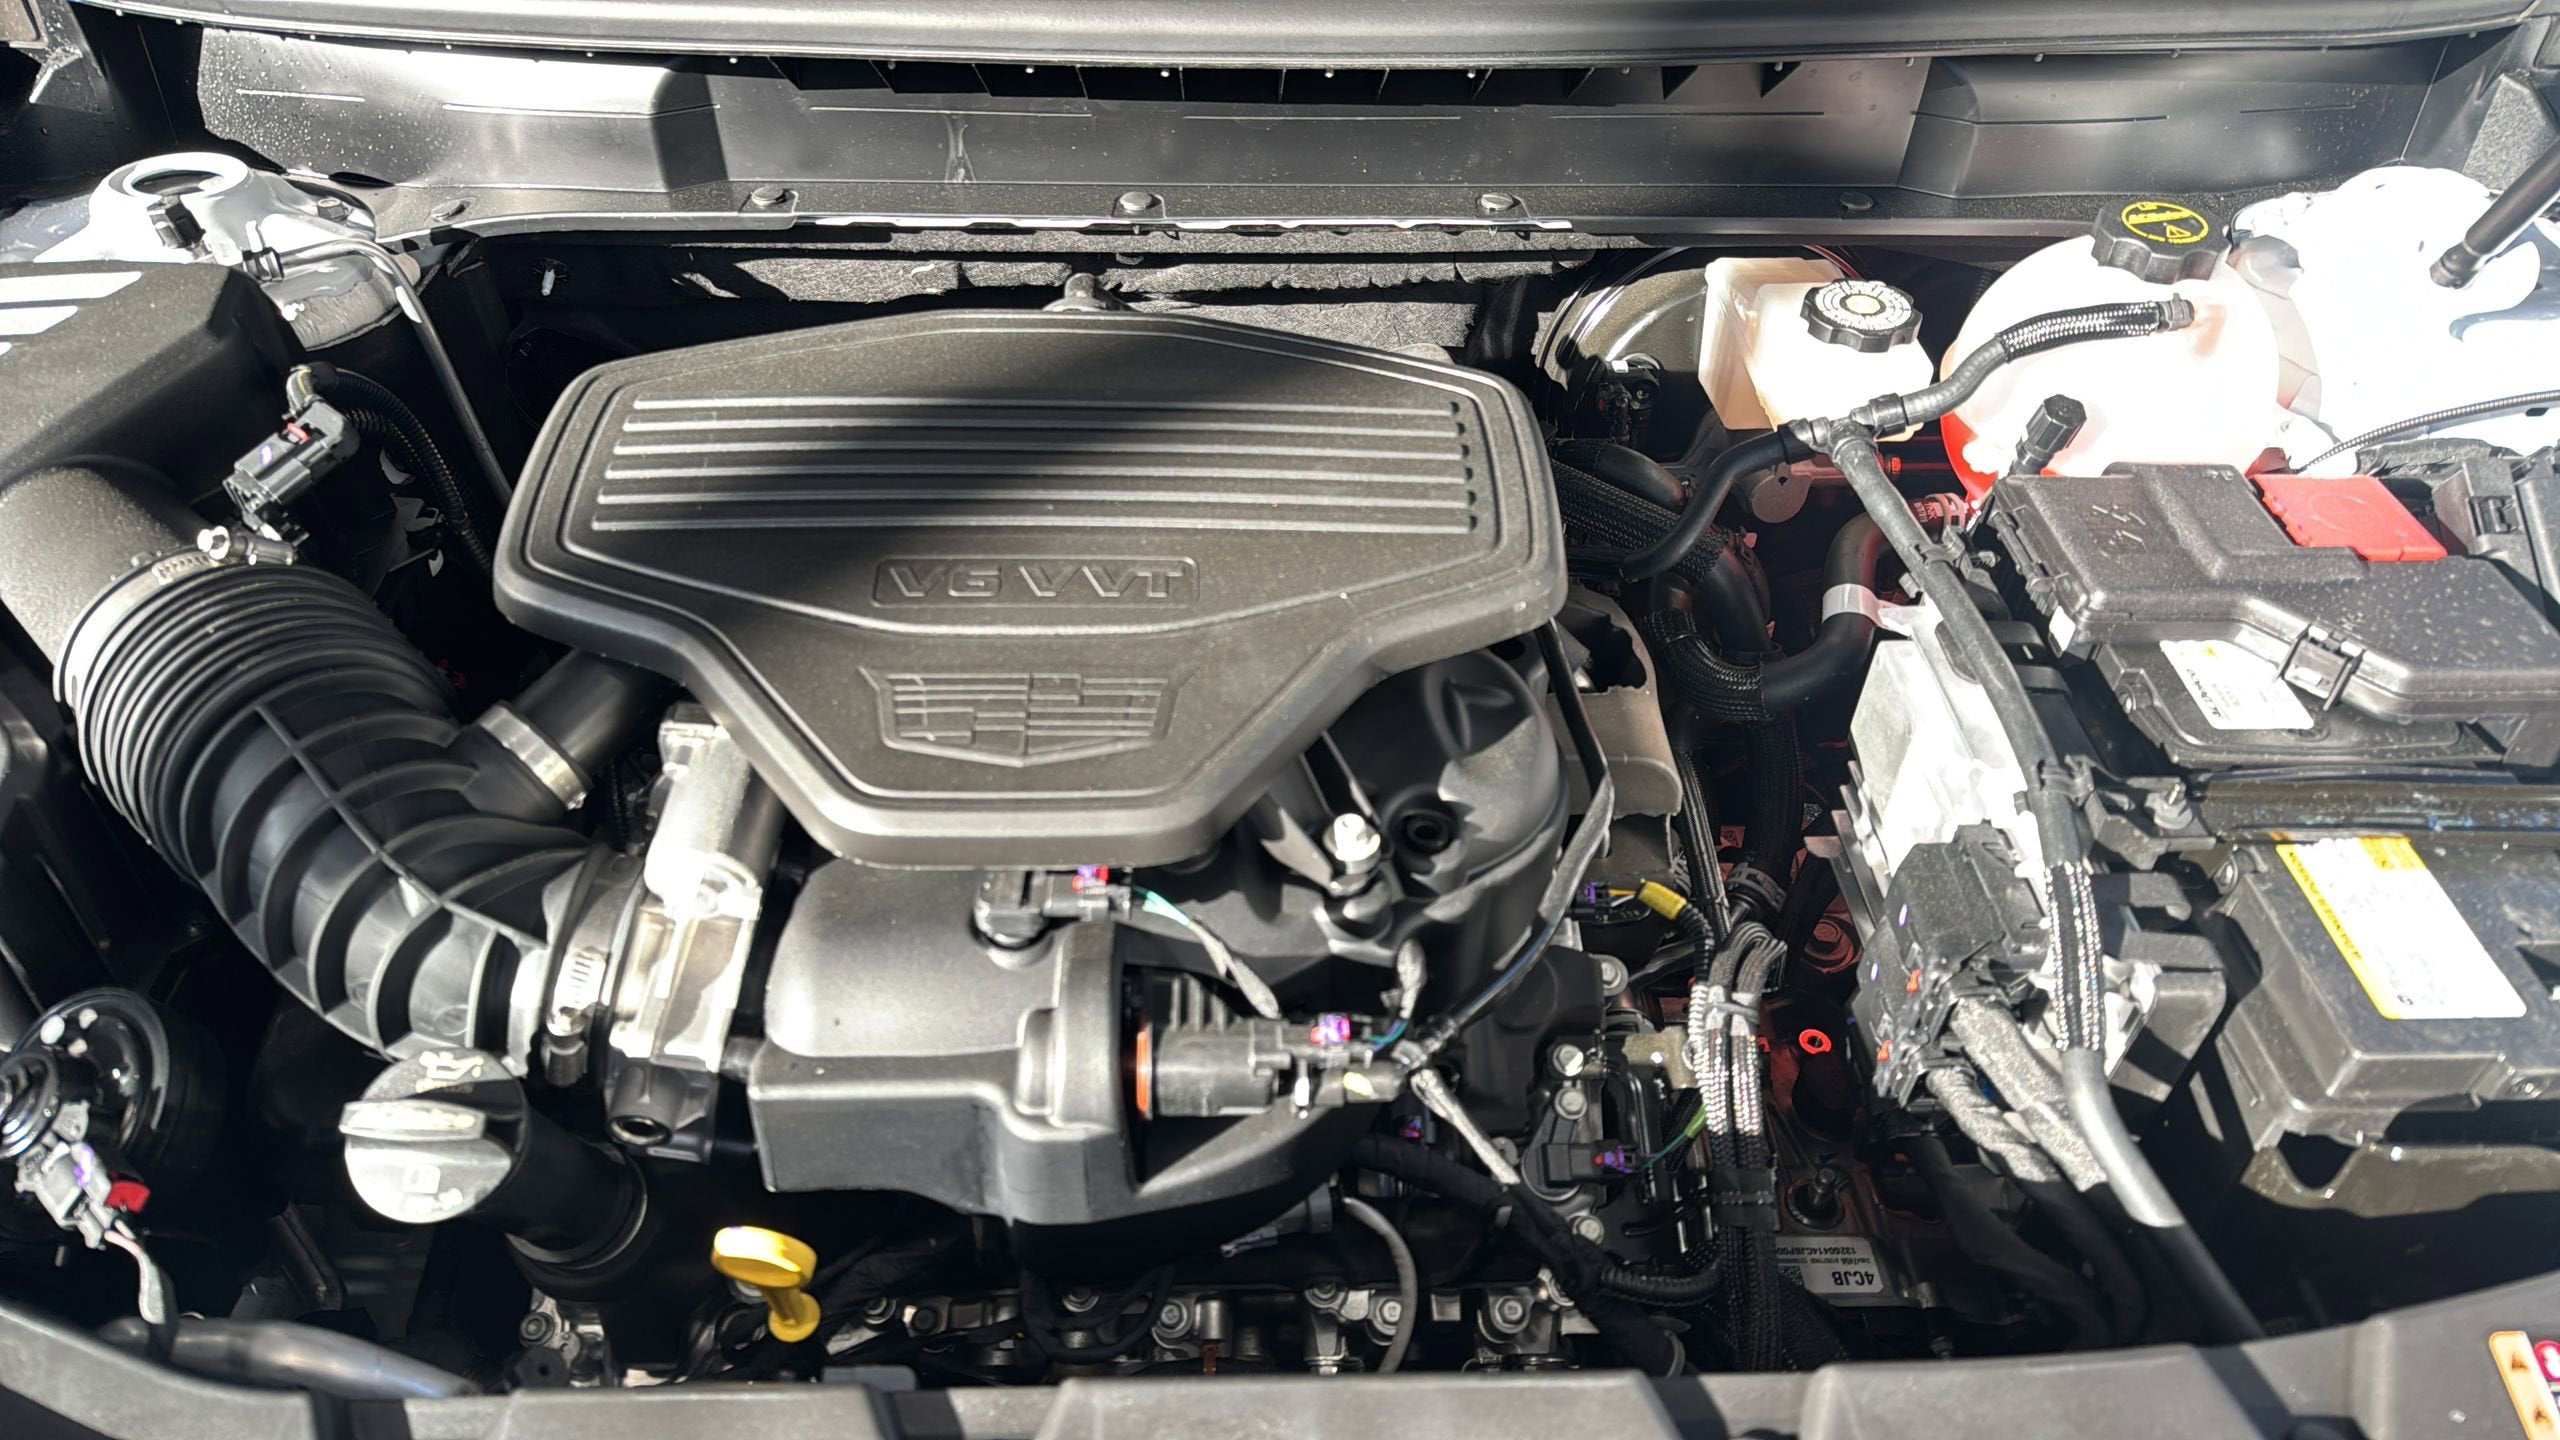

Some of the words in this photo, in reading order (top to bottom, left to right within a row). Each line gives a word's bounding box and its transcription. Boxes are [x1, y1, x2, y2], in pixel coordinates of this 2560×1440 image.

[889, 564, 1002, 598] V6
[1018, 564, 1185, 598] VVT
[1831, 1270, 1875, 1286] 4CJB
